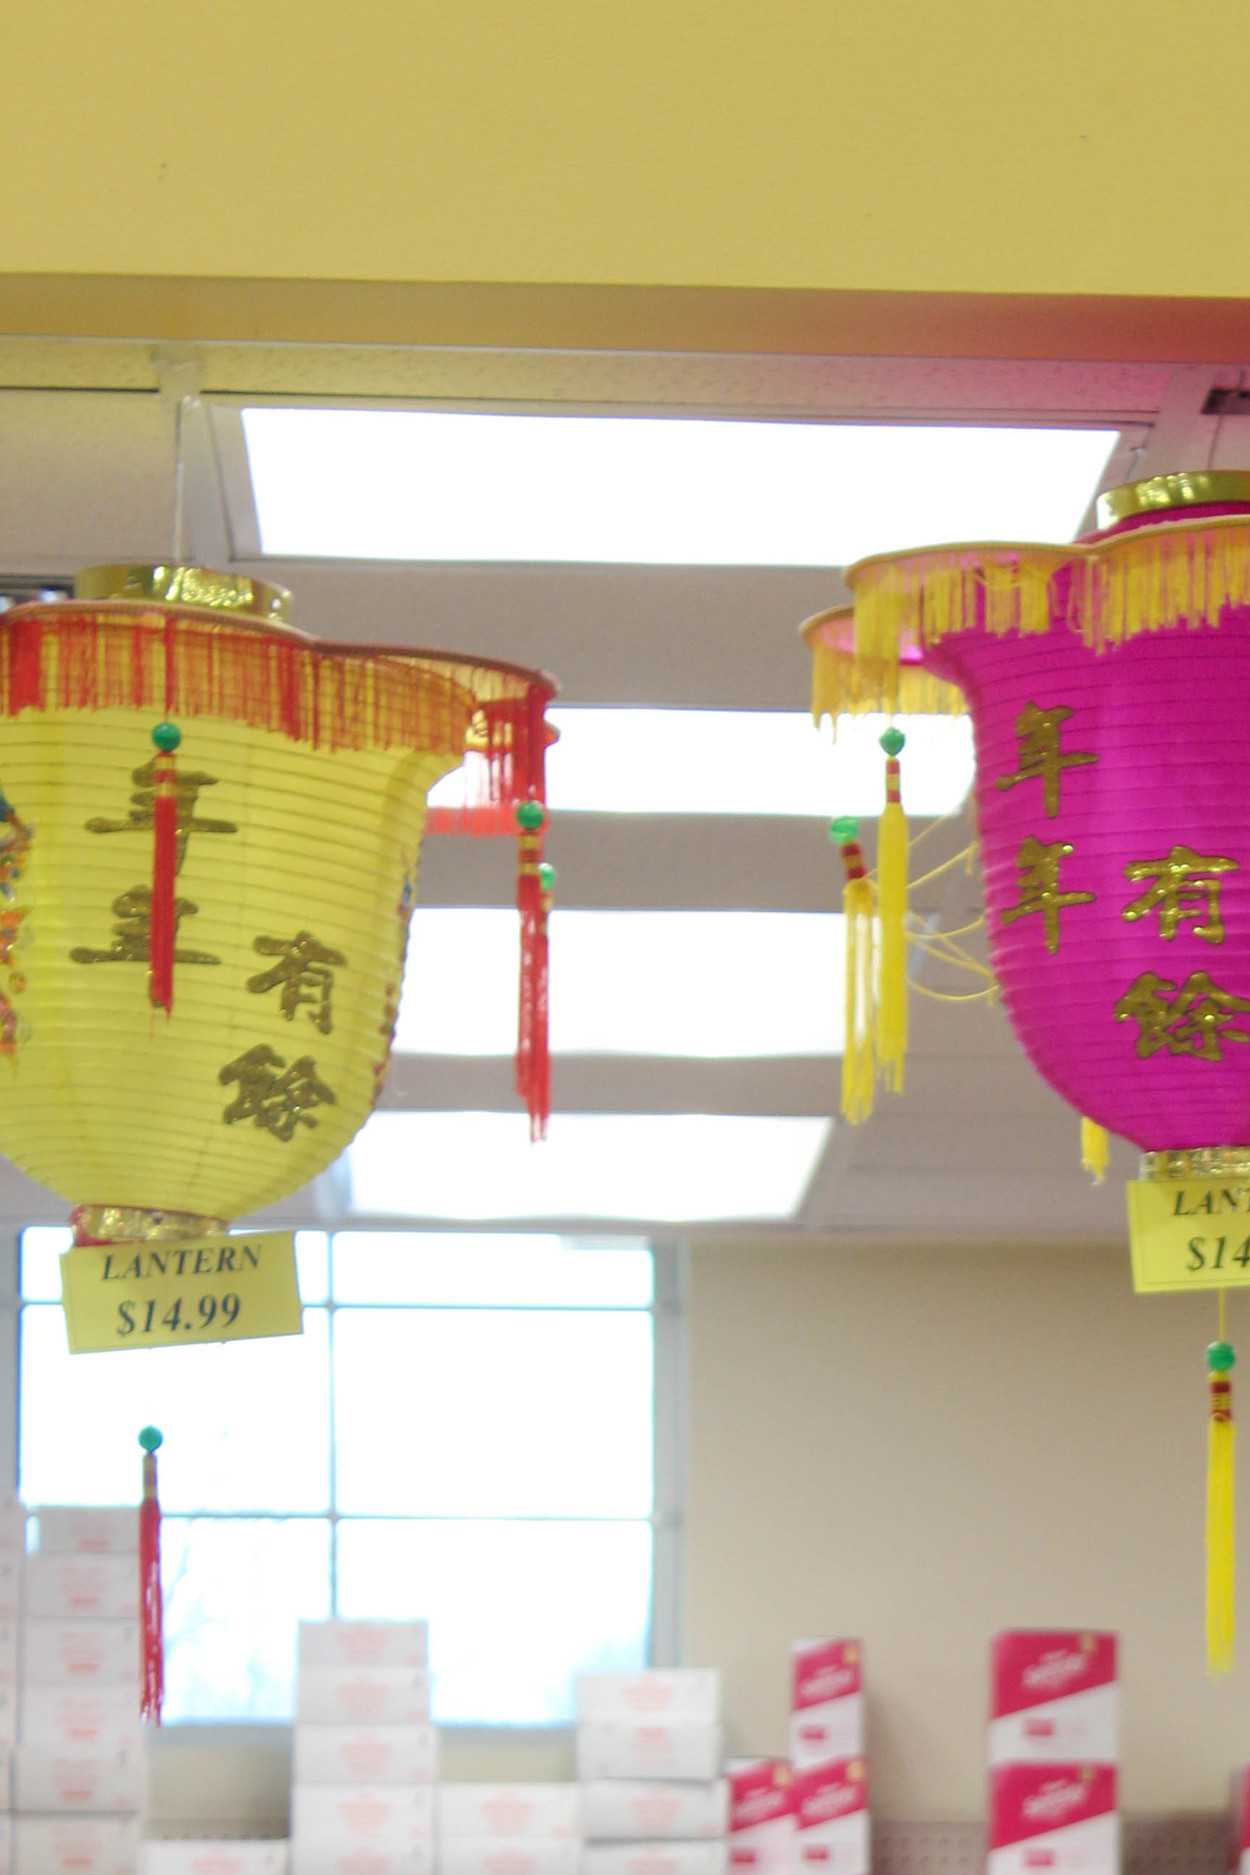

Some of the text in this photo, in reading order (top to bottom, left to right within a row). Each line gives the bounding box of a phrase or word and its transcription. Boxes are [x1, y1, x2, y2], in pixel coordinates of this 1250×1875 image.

[995, 700, 1097, 953] 年年
[102, 1244, 262, 1282] LANTERN
[116, 1293, 242, 1336] $14.99
